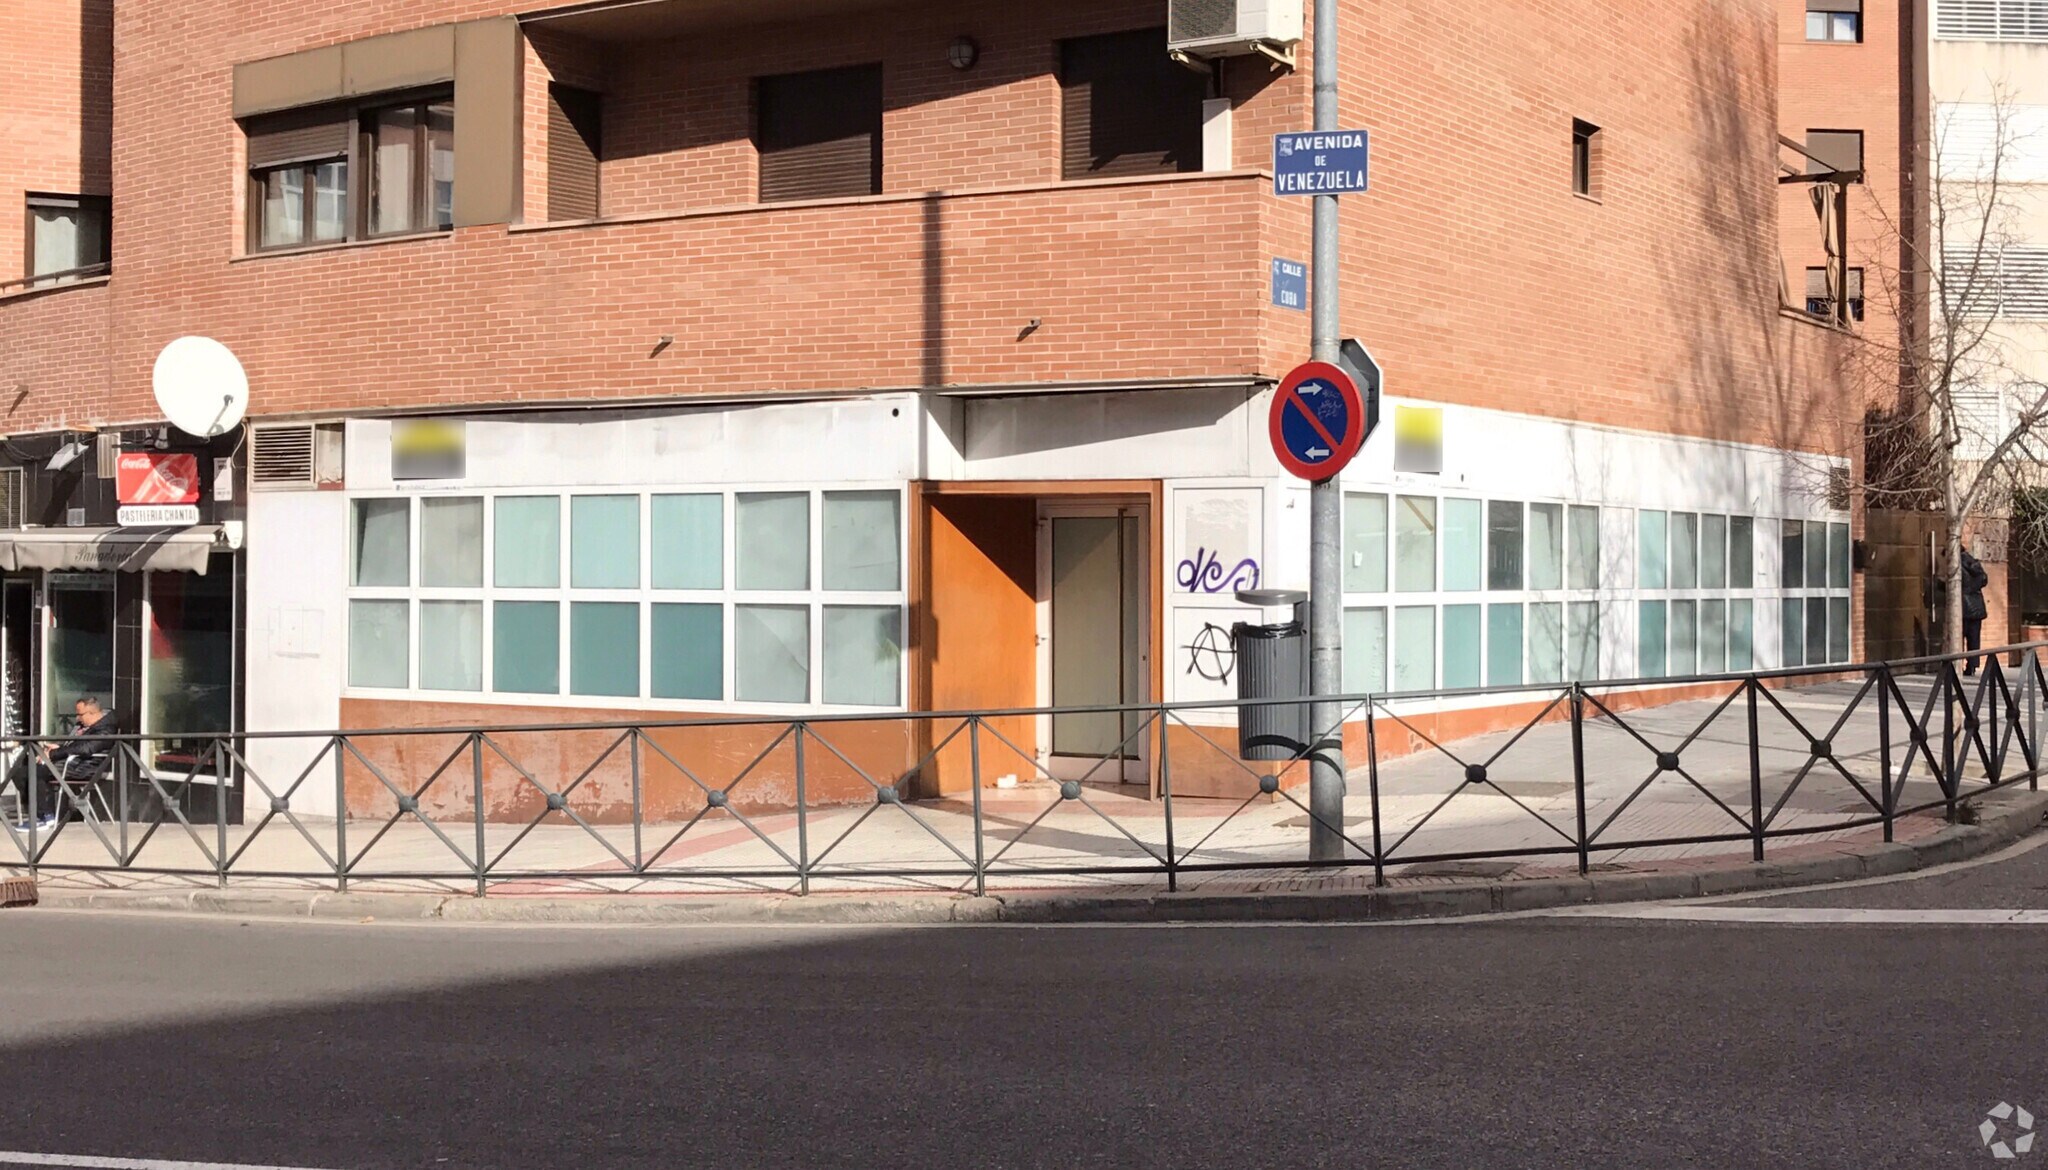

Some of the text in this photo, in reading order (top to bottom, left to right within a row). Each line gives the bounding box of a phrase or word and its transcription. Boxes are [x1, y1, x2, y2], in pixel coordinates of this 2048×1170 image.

[1295, 135, 1363, 150] AVENIDA
[1314, 155, 1326, 167] DE
[1278, 170, 1364, 191] VENEZUELA
[1282, 263, 1302, 278] CALLE
[1281, 290, 1297, 306] CUBA
[120, 509, 197, 522] PASTELERIA CHANTAL
